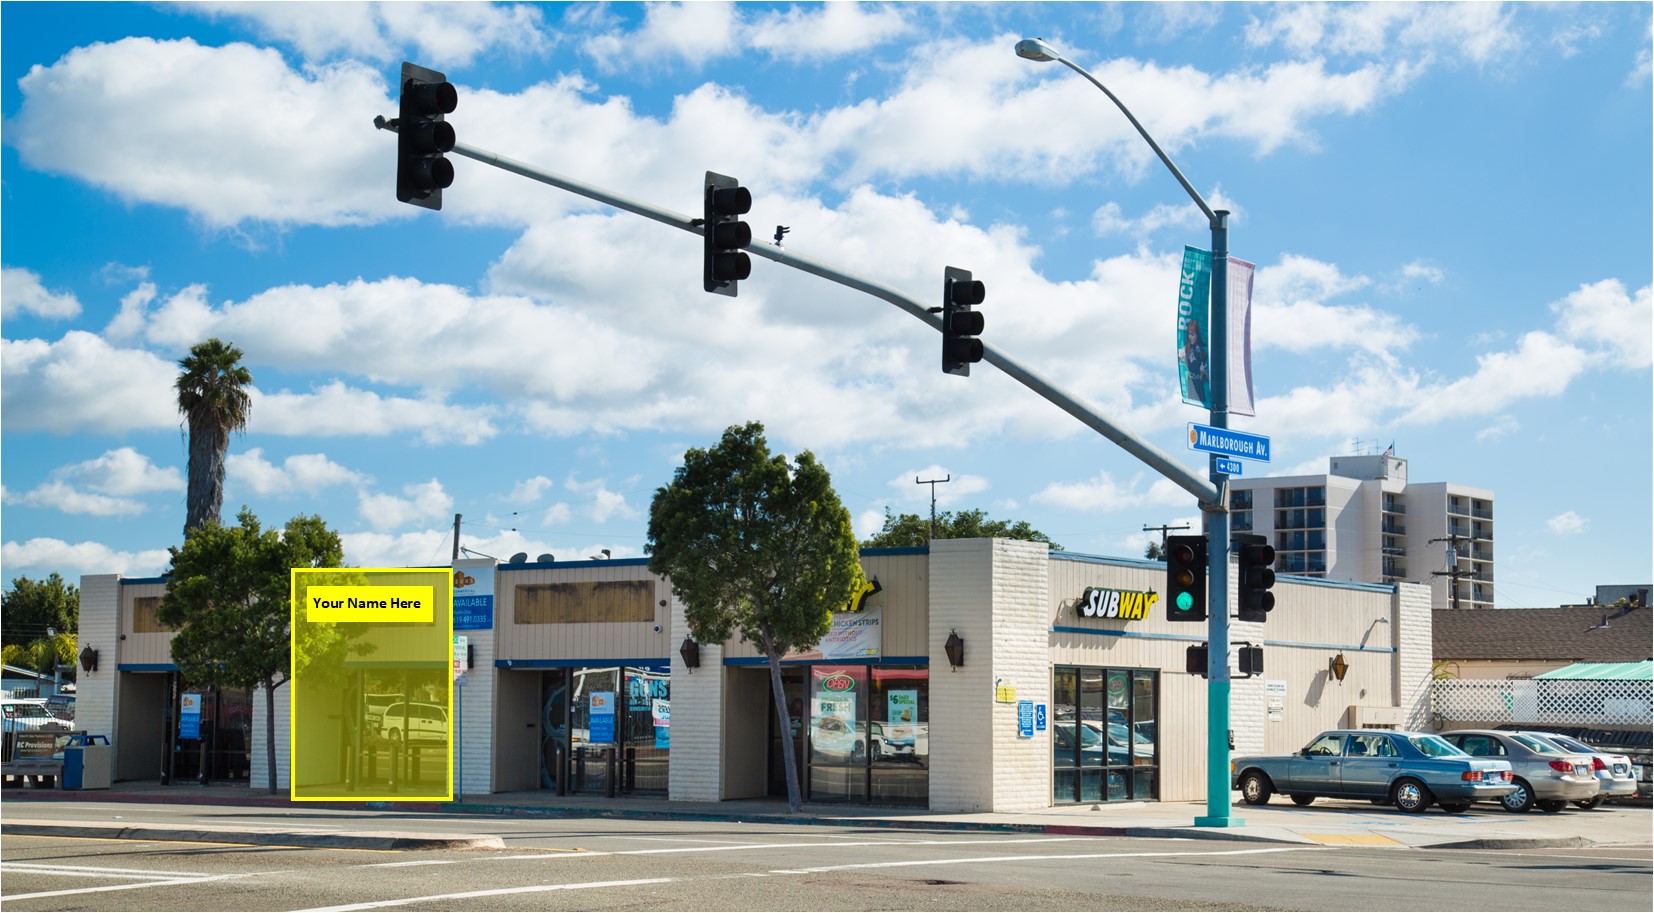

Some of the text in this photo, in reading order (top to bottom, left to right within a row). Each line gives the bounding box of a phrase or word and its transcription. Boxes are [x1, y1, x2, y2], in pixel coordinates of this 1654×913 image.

[1178, 270, 1195, 331] ROCK
[1199, 430, 1254, 454] MARLBOROUGH
[1226, 462, 1240, 473] 4300
[454, 598, 487, 607] AVAILABLE
[1083, 589, 1159, 619] SUBWAY
[858, 618, 879, 626] STRIPS
[629, 680, 668, 697] GUNS
[826, 678, 851, 690] OPEN
[889, 694, 899, 704] $6
[821, 702, 851, 712] FRESH
[16, 741, 53, 749] RC Provisions
